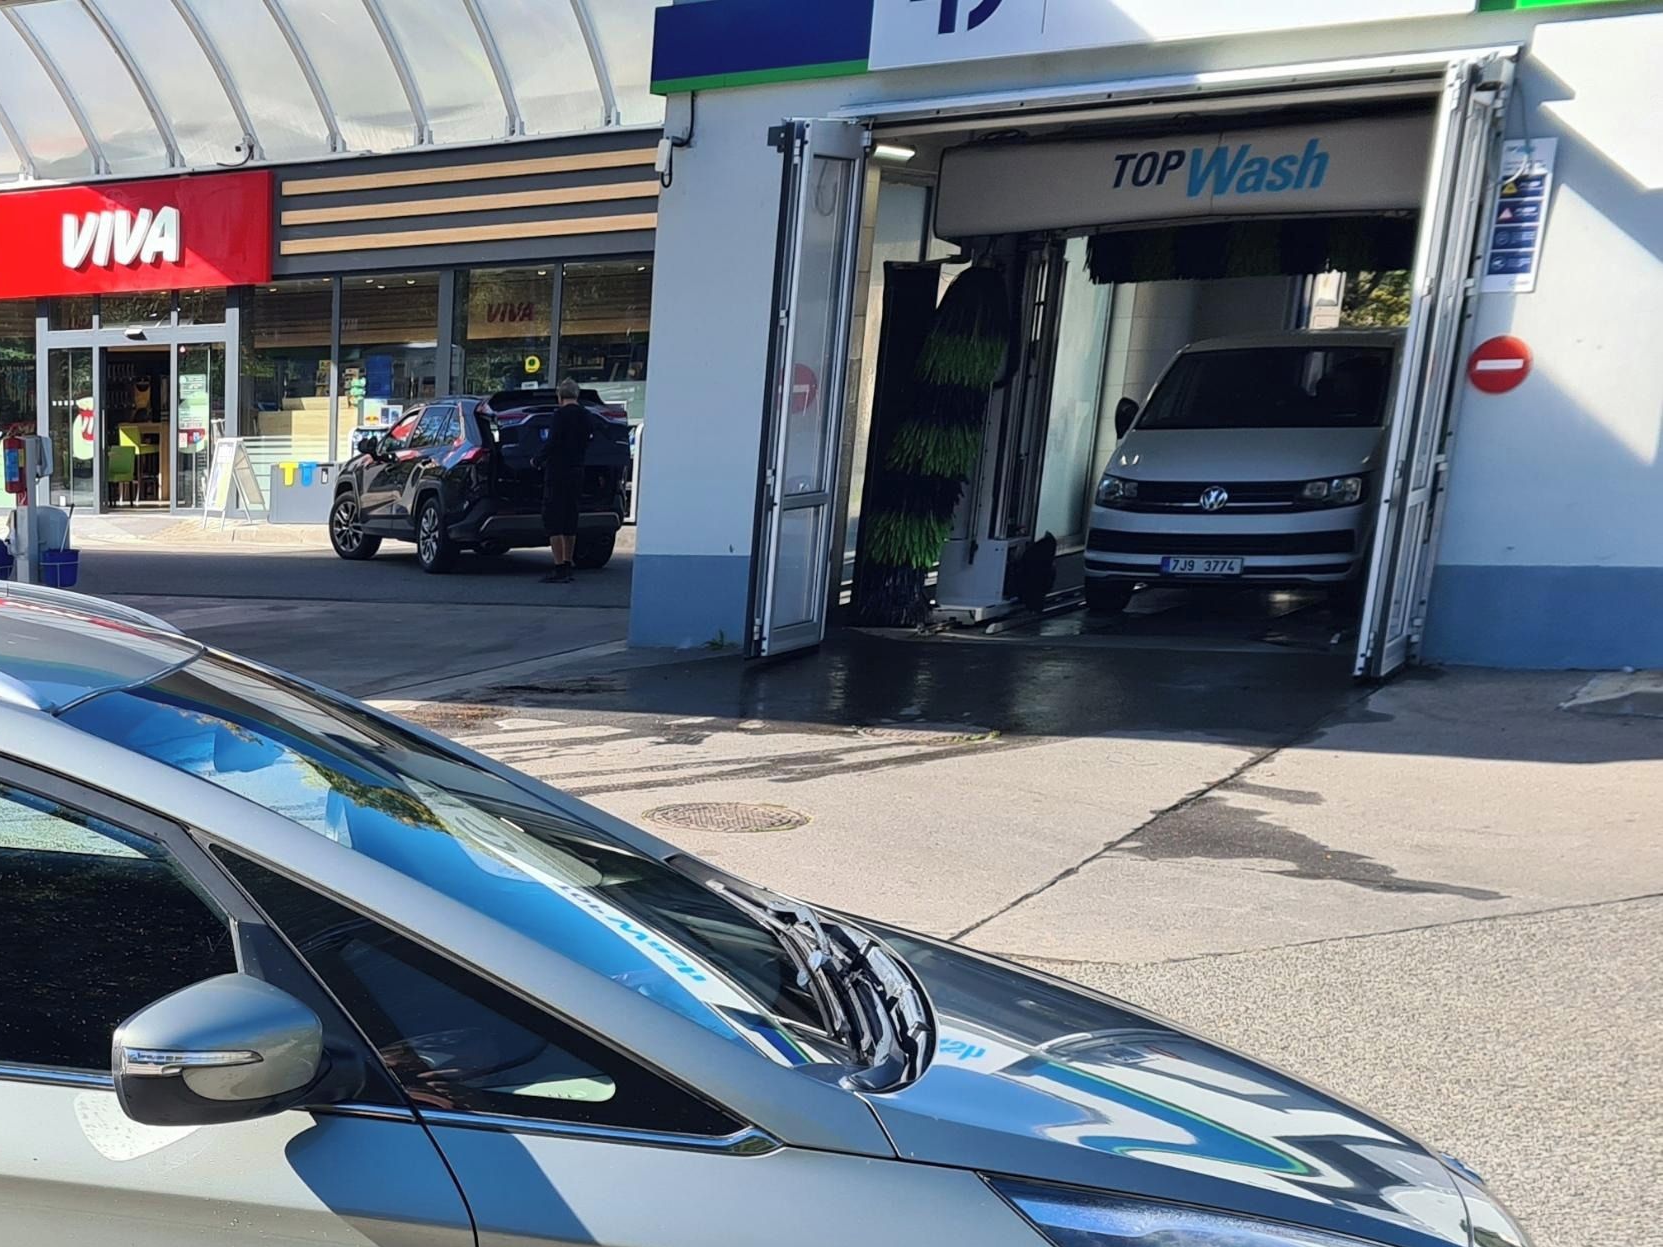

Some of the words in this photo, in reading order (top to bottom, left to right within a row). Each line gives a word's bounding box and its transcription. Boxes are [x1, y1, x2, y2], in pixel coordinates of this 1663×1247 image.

[62, 206, 180, 269] VIVA
[487, 302, 534, 323] VIVA
[1171, 559, 1195, 572] 7J9
[1203, 560, 1235, 573] 3774
